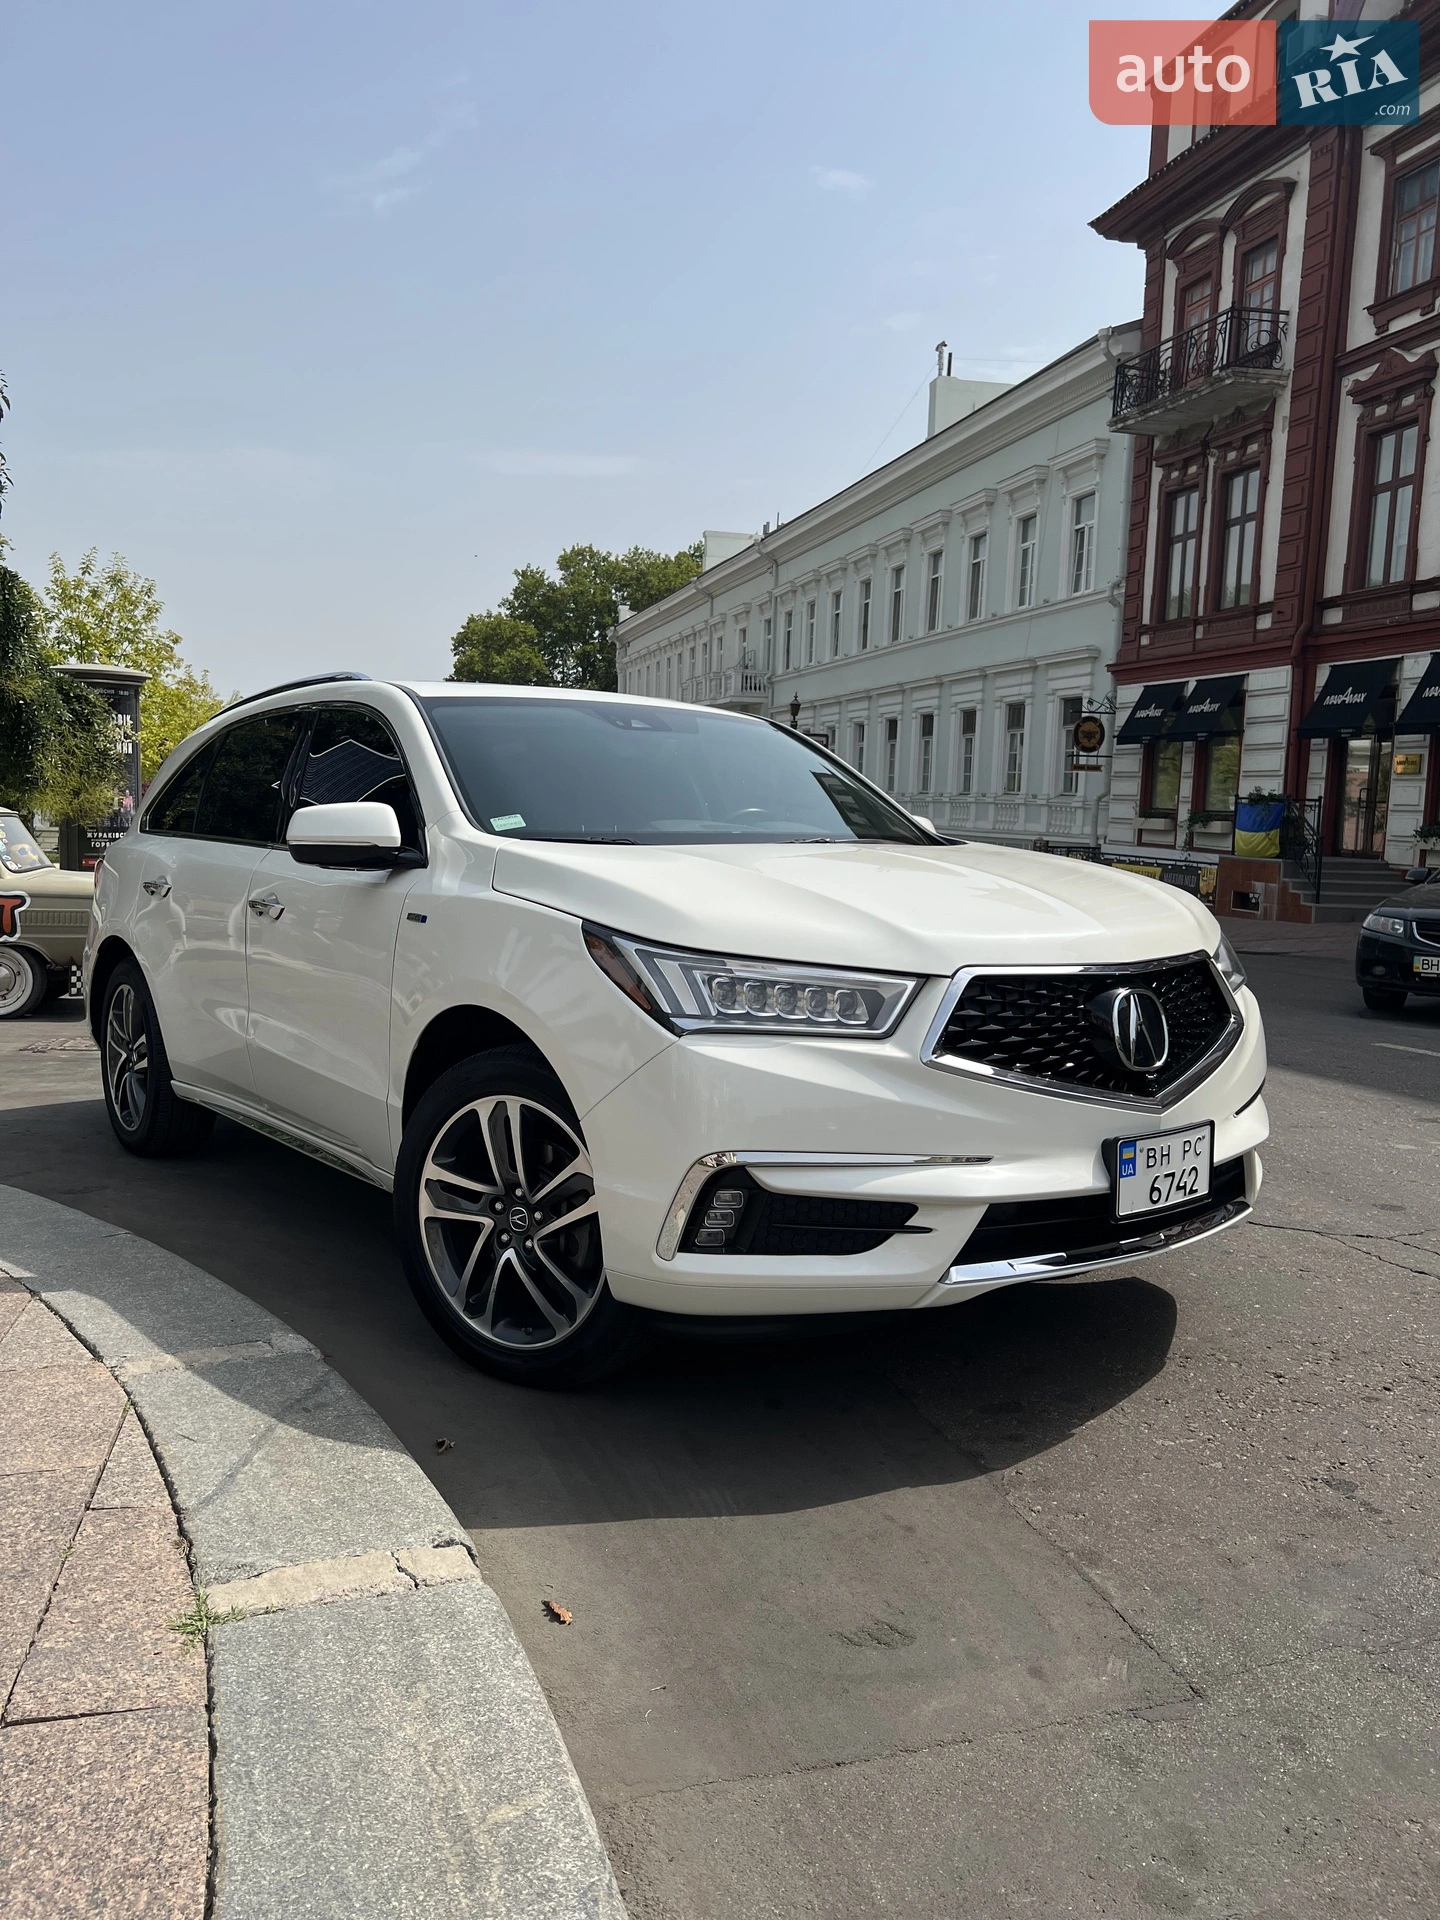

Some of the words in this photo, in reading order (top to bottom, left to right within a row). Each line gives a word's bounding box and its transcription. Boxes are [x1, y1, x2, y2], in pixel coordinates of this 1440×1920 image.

[1146, 1144, 1171, 1168] BH
[1182, 1136, 1203, 1161] PC
[1122, 1163, 1134, 1176] UA
[1149, 1165, 1199, 1205] 6742
